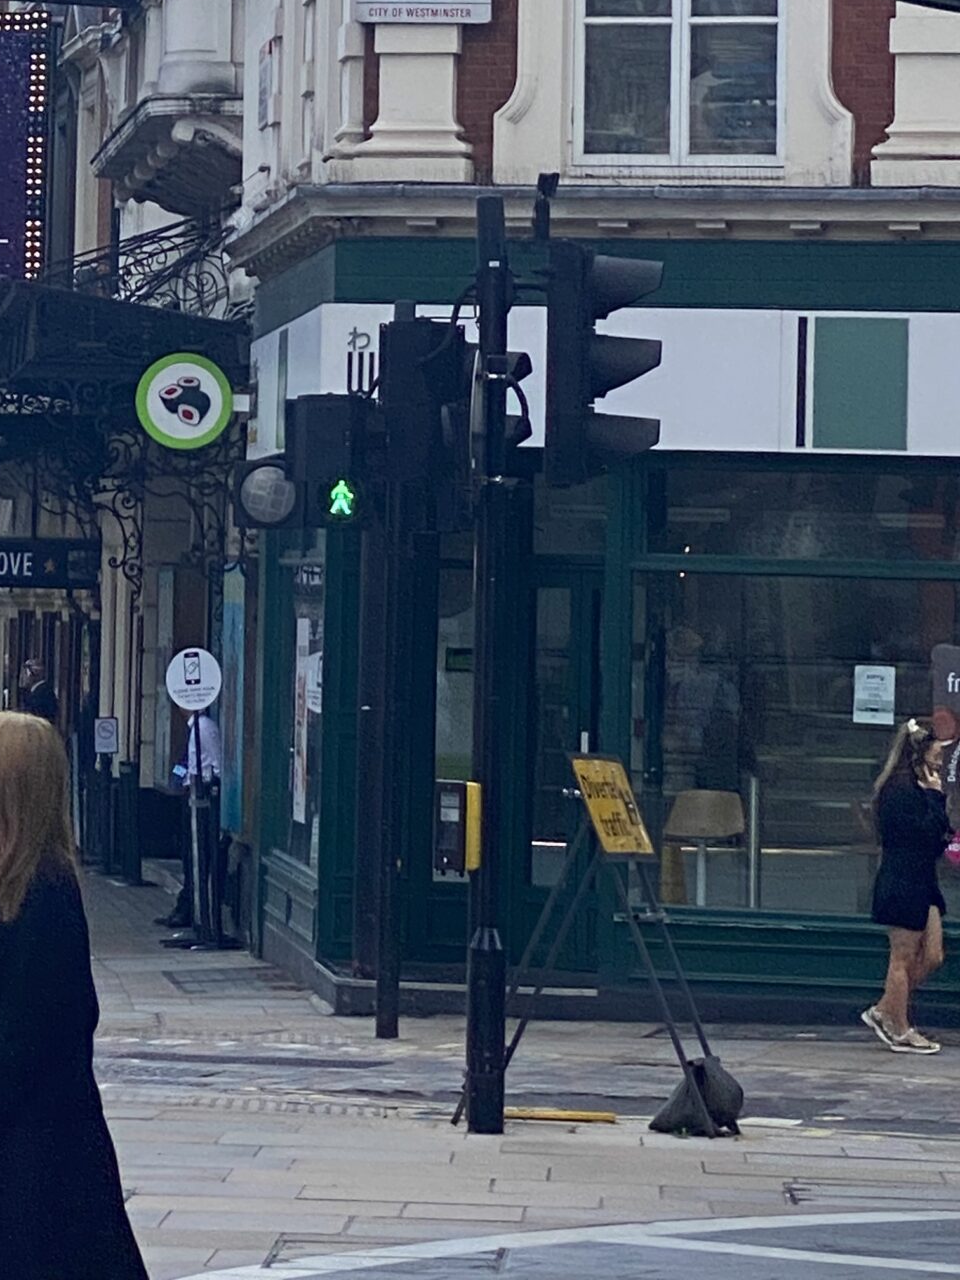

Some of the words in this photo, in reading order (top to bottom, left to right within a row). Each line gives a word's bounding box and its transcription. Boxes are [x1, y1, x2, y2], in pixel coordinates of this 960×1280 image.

[368, 8, 389, 17] CITY
[392, 8, 403, 17] OF
[406, 8, 472, 18] WESTMINSTER
